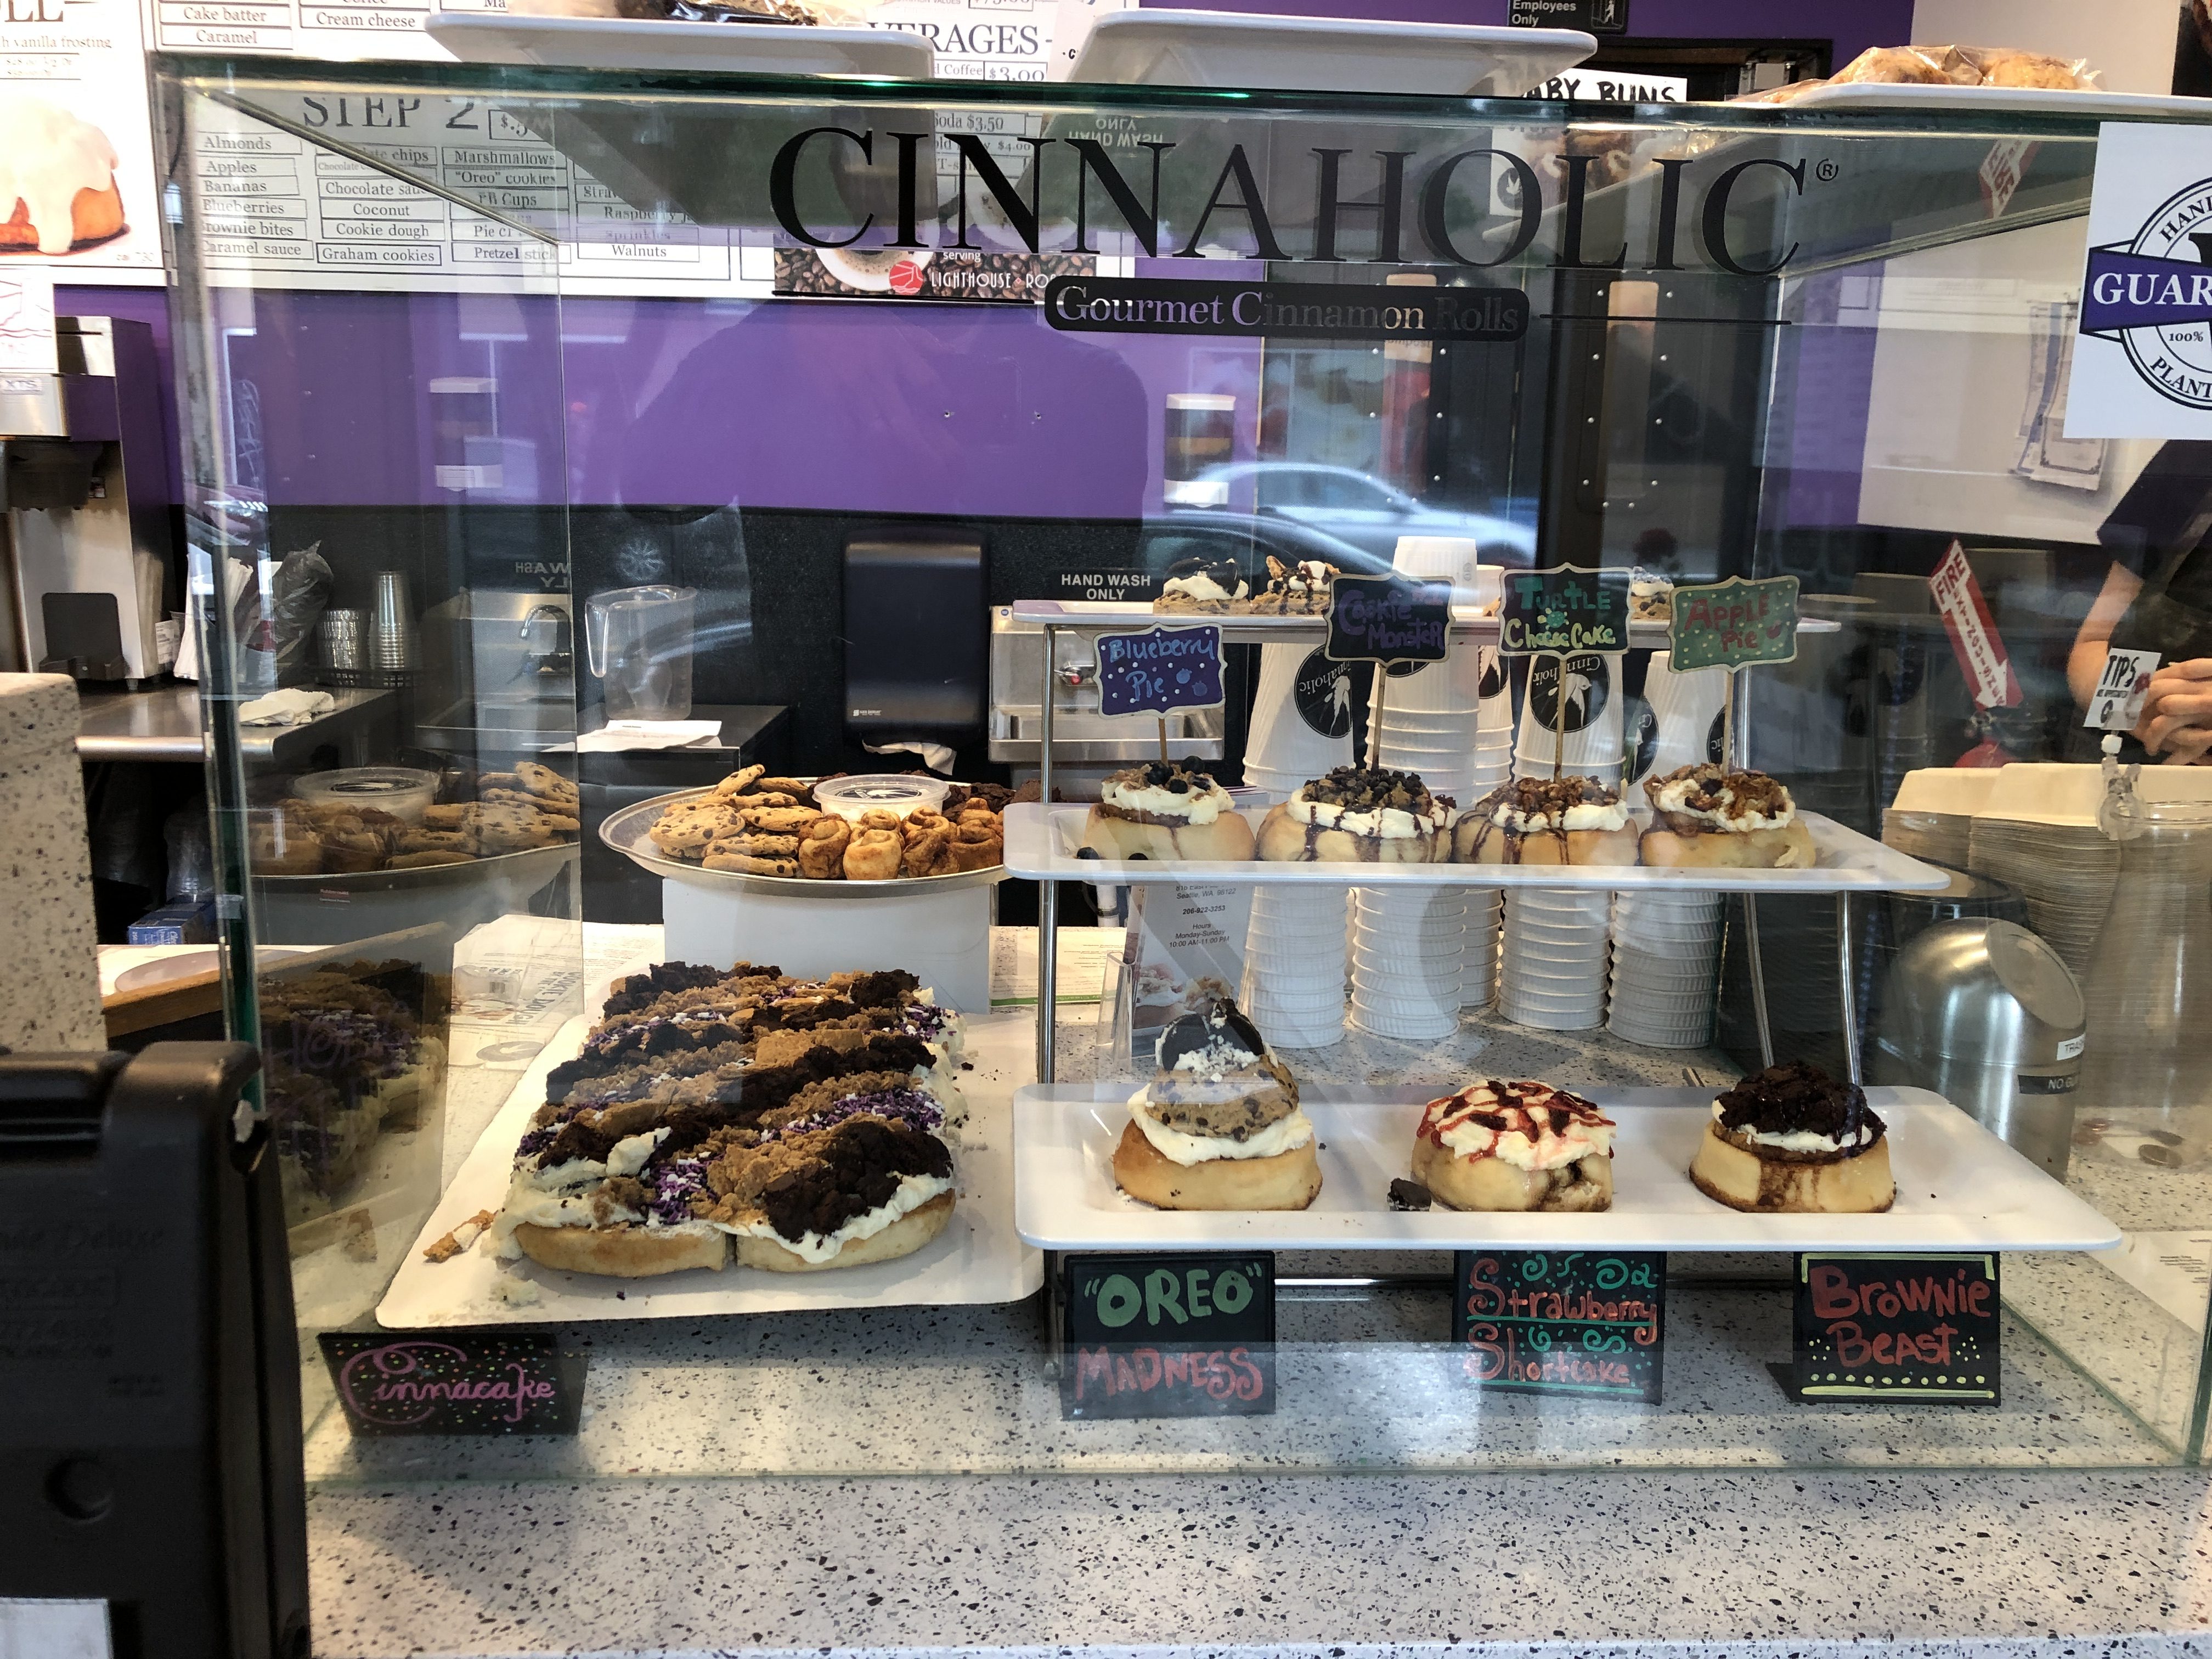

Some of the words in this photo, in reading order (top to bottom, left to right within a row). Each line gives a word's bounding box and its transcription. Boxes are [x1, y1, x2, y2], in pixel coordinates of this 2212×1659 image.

[183, 6, 219, 20] Cake
[222, 7, 268, 22] batter
[1513, 0, 1576, 13] Employees
[316, 11, 364, 26] Cream
[368, 13, 416, 28] cheese
[1511, 14, 1539, 27] Only
[14, 36, 57, 48] vanilla
[61, 36, 112, 49] frosting
[196, 29, 258, 44] Caramel
[944, 64, 983, 76] Coffee
[967, 114, 1005, 133] $3.50
[204, 135, 272, 150] Almonds
[391, 148, 429, 163] chips
[455, 150, 556, 165] Marshmallows
[206, 160, 257, 176] Apples
[204, 179, 267, 192] Bananas
[325, 182, 393, 195] Chocolate
[203, 199, 285, 214] Blueberries
[502, 192, 538, 208] Cups
[353, 203, 410, 216] Coconut
[259, 221, 294, 236] bites
[336, 222, 383, 235] Cookie
[388, 223, 430, 239] dough
[474, 225, 497, 237] Pie
[263, 245, 302, 255] sauce
[322, 247, 378, 260] Graham
[382, 249, 435, 261] cookies
[474, 246, 520, 259] Pretzel
[611, 244, 667, 257] Walnuts
[943, 251, 981, 263] serving
[931, 272, 1011, 289] LIGHTHOUSE
[1056, 284, 1224, 326] Gourmet
[1231, 291, 1426, 330] Cinnamon
[1433, 296, 1520, 332] Rolls
[2169, 330, 2204, 342] 100%
[1061, 574, 1104, 586] HAND
[1107, 574, 1151, 586] WASH
[1936, 551, 1966, 605] FIRE
[1086, 588, 1126, 601] ONLY
[1109, 637, 1215, 663] Blueberry
[1532, 656, 1601, 686] Cinnholic
[2102, 654, 2141, 688] TIPS
[1125, 670, 1165, 699] Pie
[1175, 929, 1226, 940] Monday-Sunday
[2048, 1078, 2064, 1090] NO
[1466, 1258, 1657, 1346] Strawberry
[1463, 1322, 1631, 1383] Shortcake
[340, 1341, 556, 1425] Cinnacake
